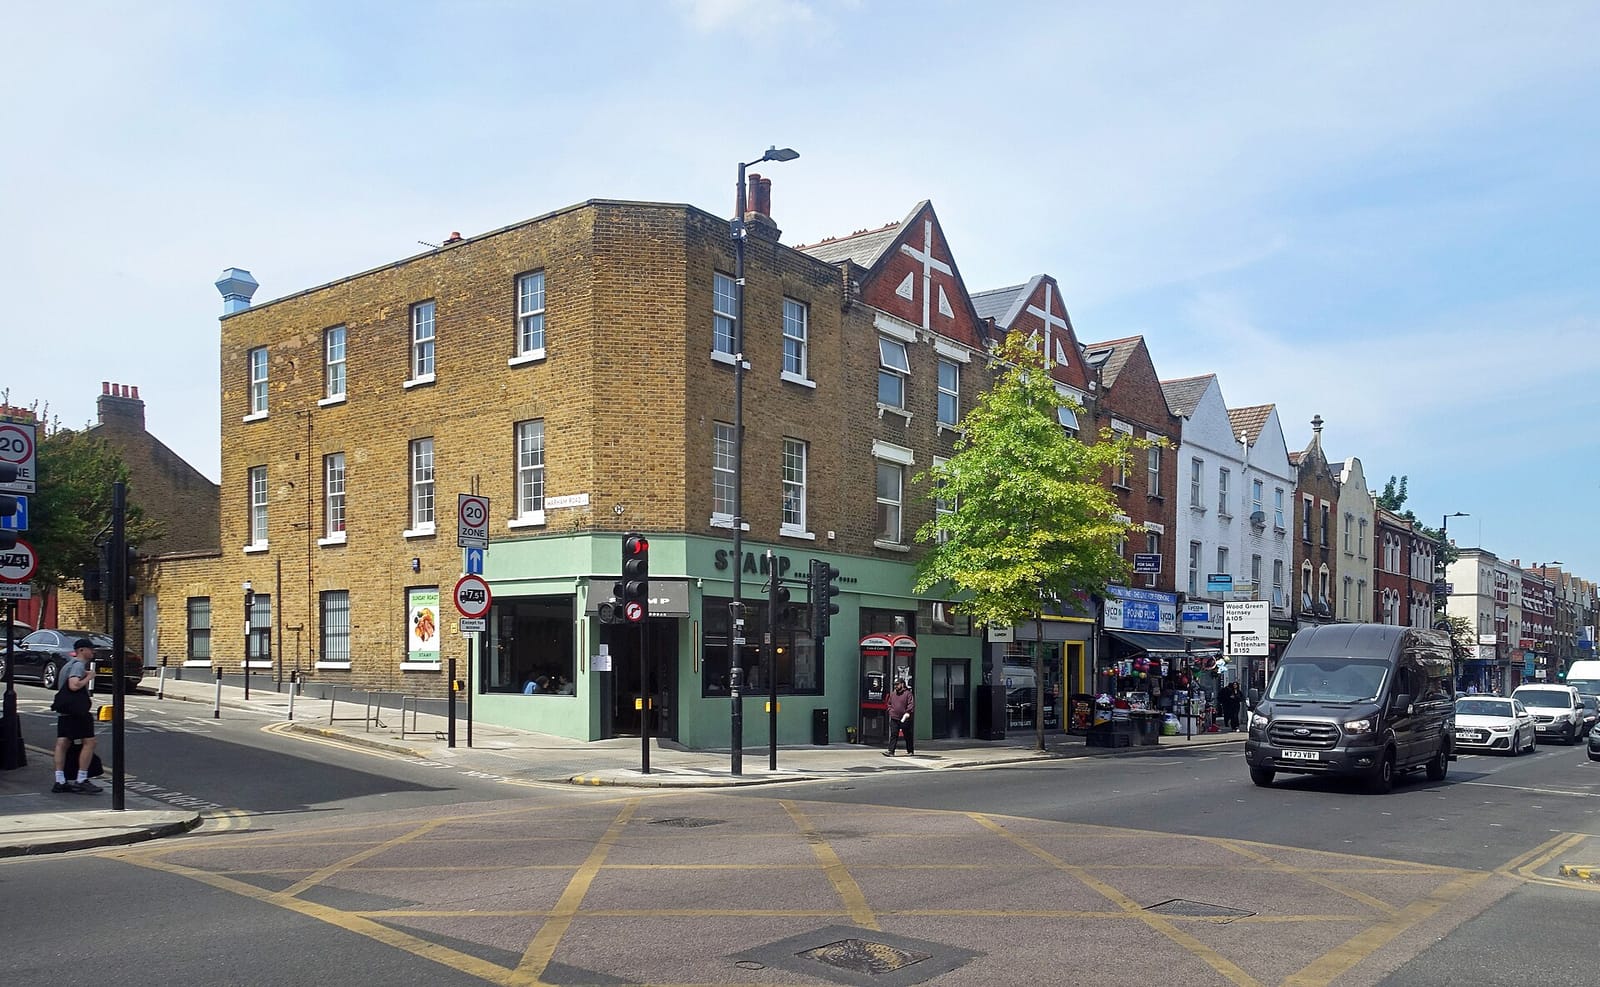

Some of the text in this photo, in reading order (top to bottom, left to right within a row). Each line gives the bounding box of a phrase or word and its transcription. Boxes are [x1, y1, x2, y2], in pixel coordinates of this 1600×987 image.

[0, 437, 24, 453] 20
[466, 506, 482, 519] 20
[462, 527, 485, 537] ZONE
